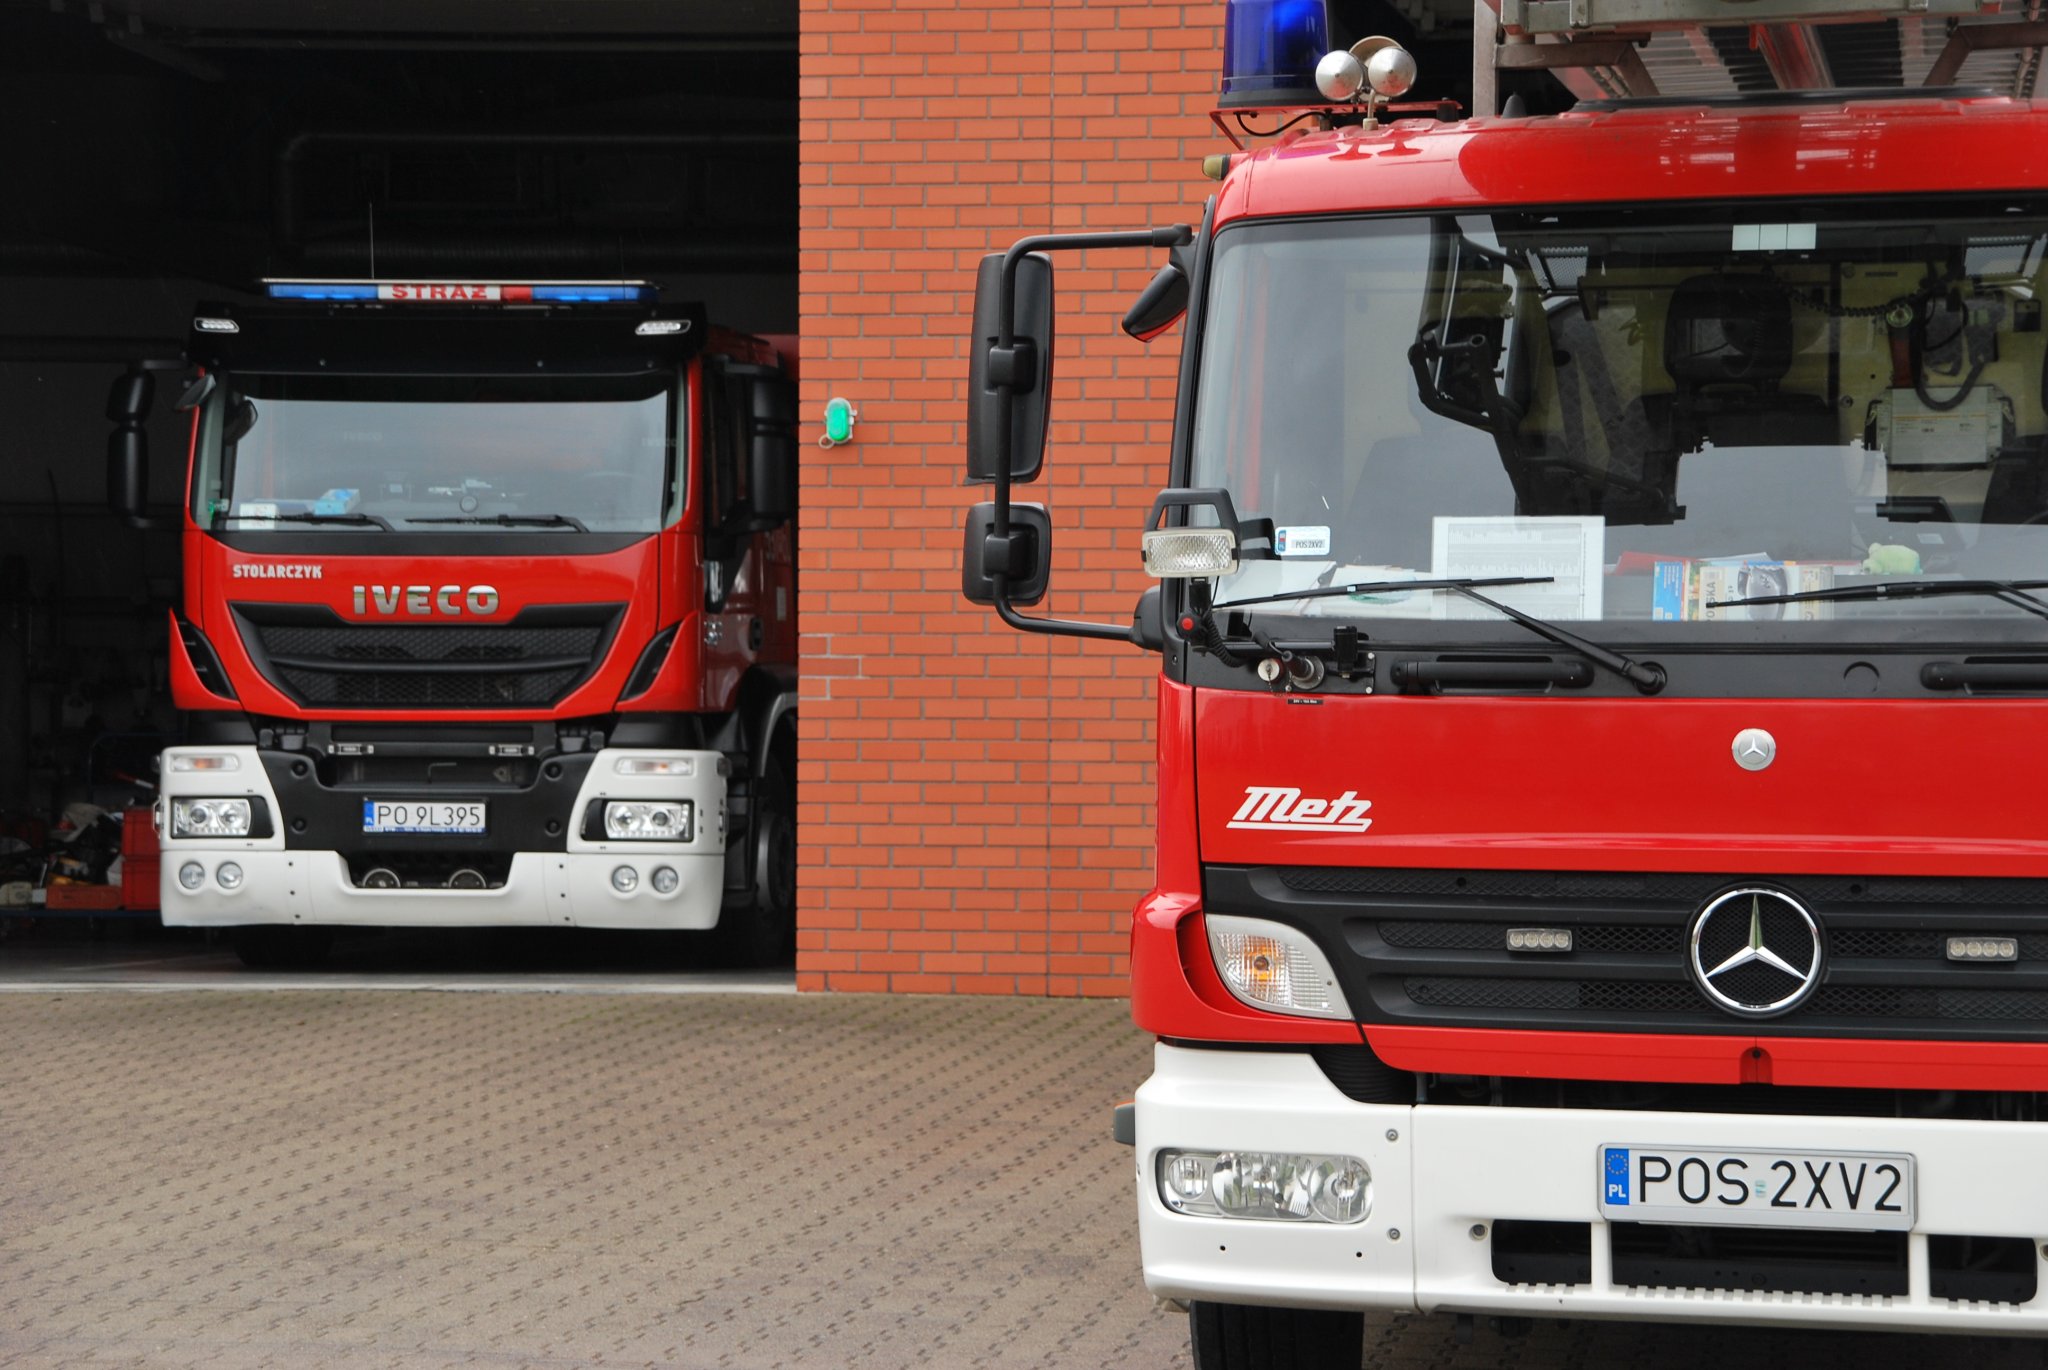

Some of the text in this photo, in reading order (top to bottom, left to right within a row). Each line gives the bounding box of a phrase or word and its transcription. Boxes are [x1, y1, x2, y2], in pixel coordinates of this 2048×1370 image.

[232, 564, 323, 580] STOLARCZYK
[352, 585, 499, 616] IVECO
[1705, 581, 1716, 622] OSKA
[416, 806, 480, 826] 9L395
[1226, 786, 1373, 833] Metz
[1608, 1183, 1627, 1198] PL
[1638, 1155, 1903, 1212] POS 2XV2
